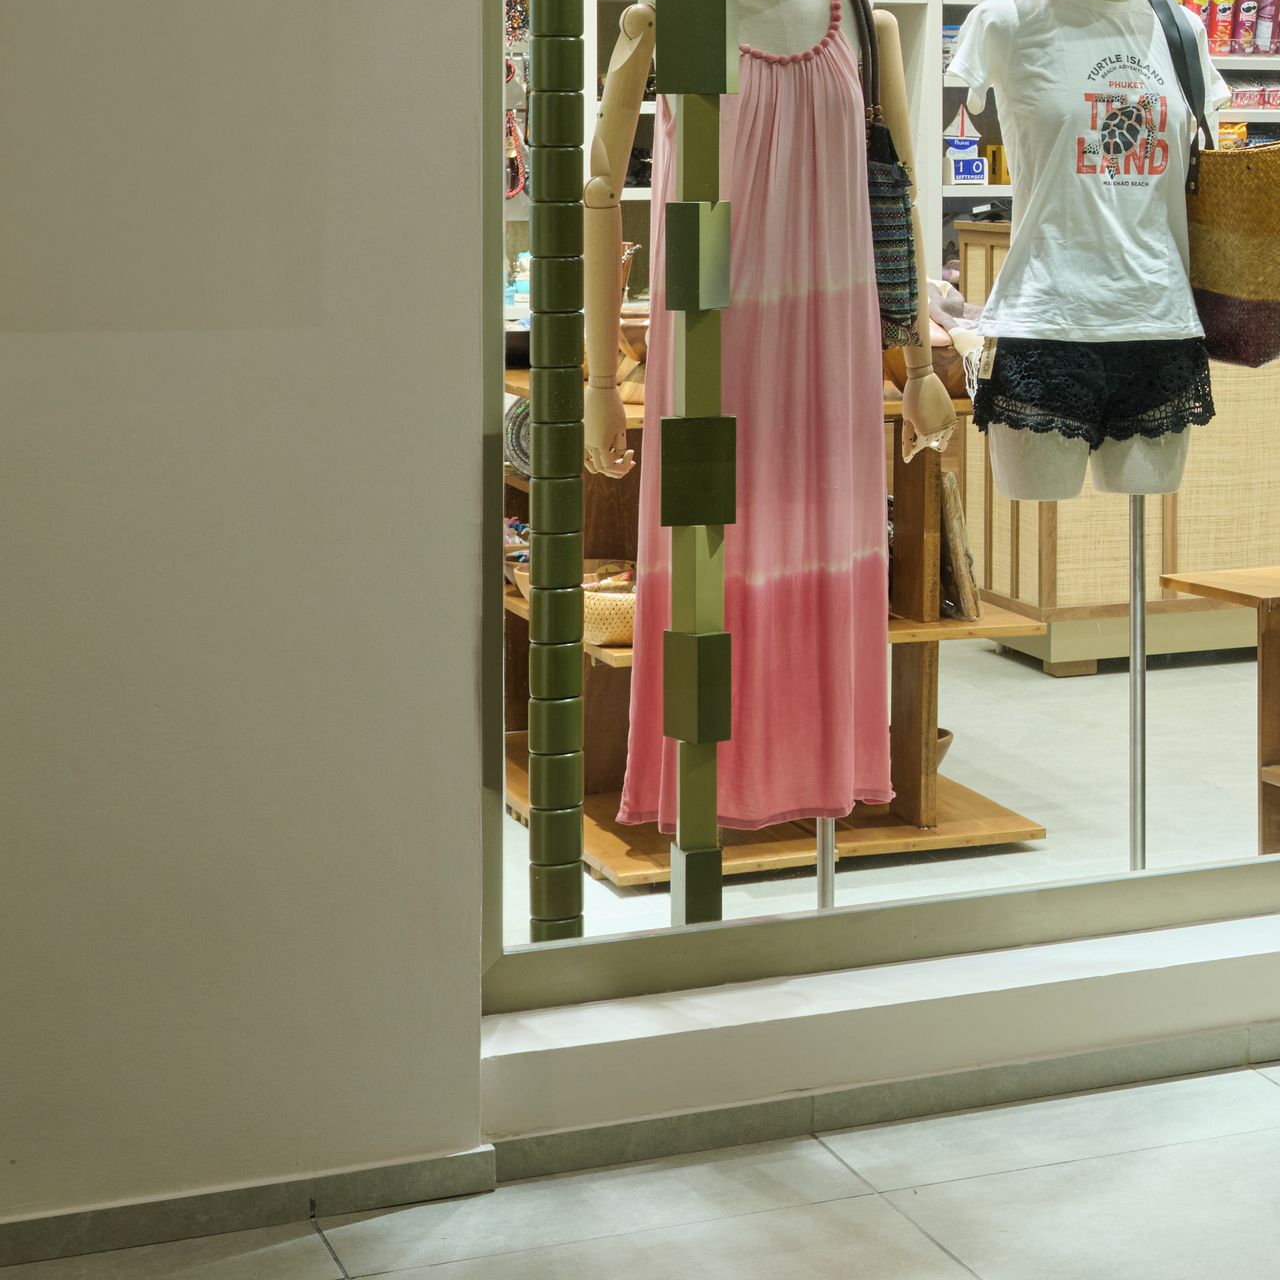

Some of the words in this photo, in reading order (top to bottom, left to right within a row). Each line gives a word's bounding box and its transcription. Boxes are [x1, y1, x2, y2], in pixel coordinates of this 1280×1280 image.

[1087, 54, 1123, 82] TURTLE
[1126, 55, 1165, 86] ISLAND
[1108, 80, 1145, 89] PHUKET
